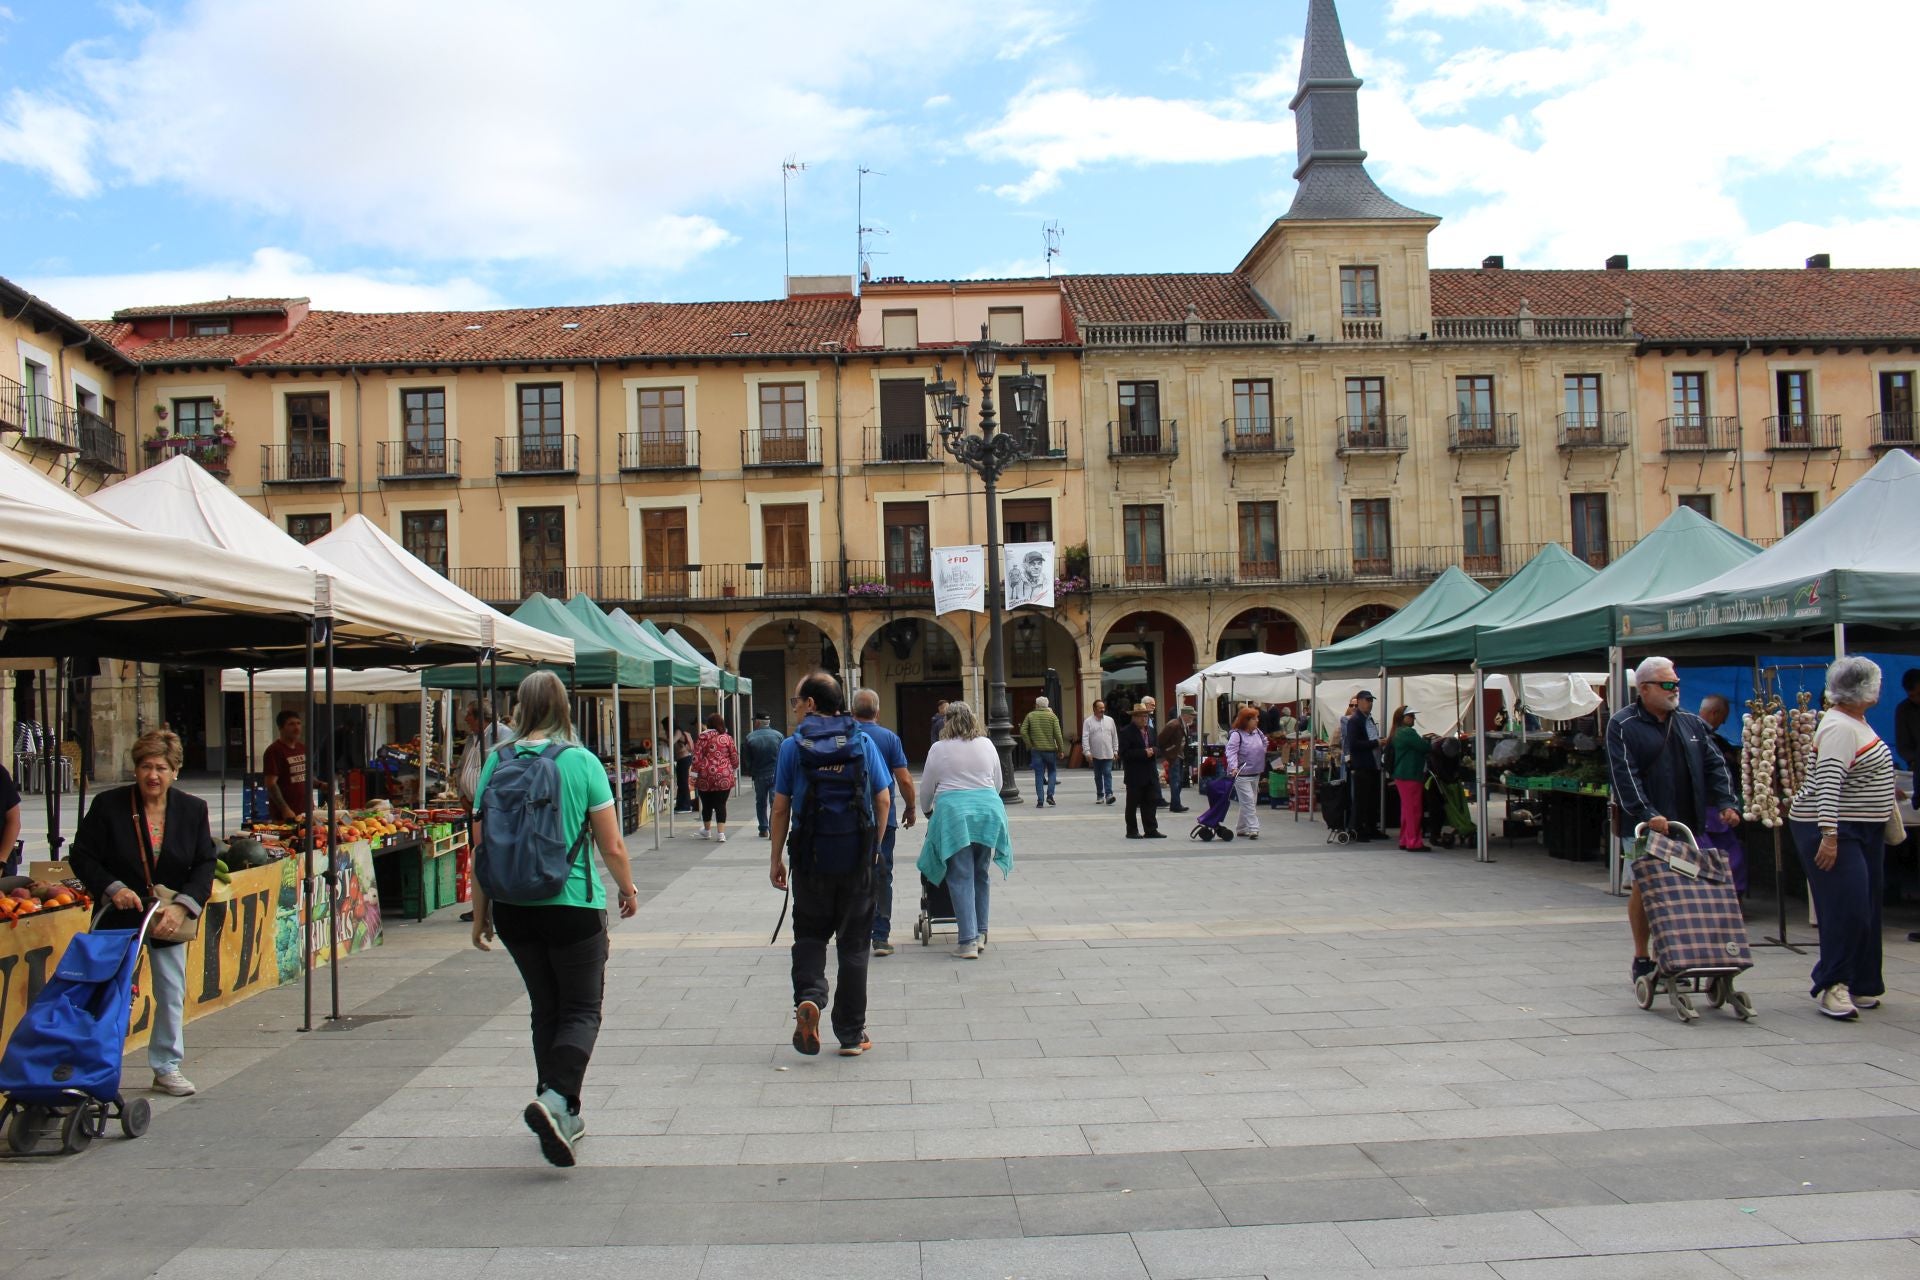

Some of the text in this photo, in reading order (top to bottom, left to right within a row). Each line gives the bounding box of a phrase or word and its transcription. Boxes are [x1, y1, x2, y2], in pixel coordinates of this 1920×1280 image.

[1667, 607, 1697, 632] Mercado
[1739, 598, 1762, 621] Plaza
[1762, 595, 1789, 622] Mayor
